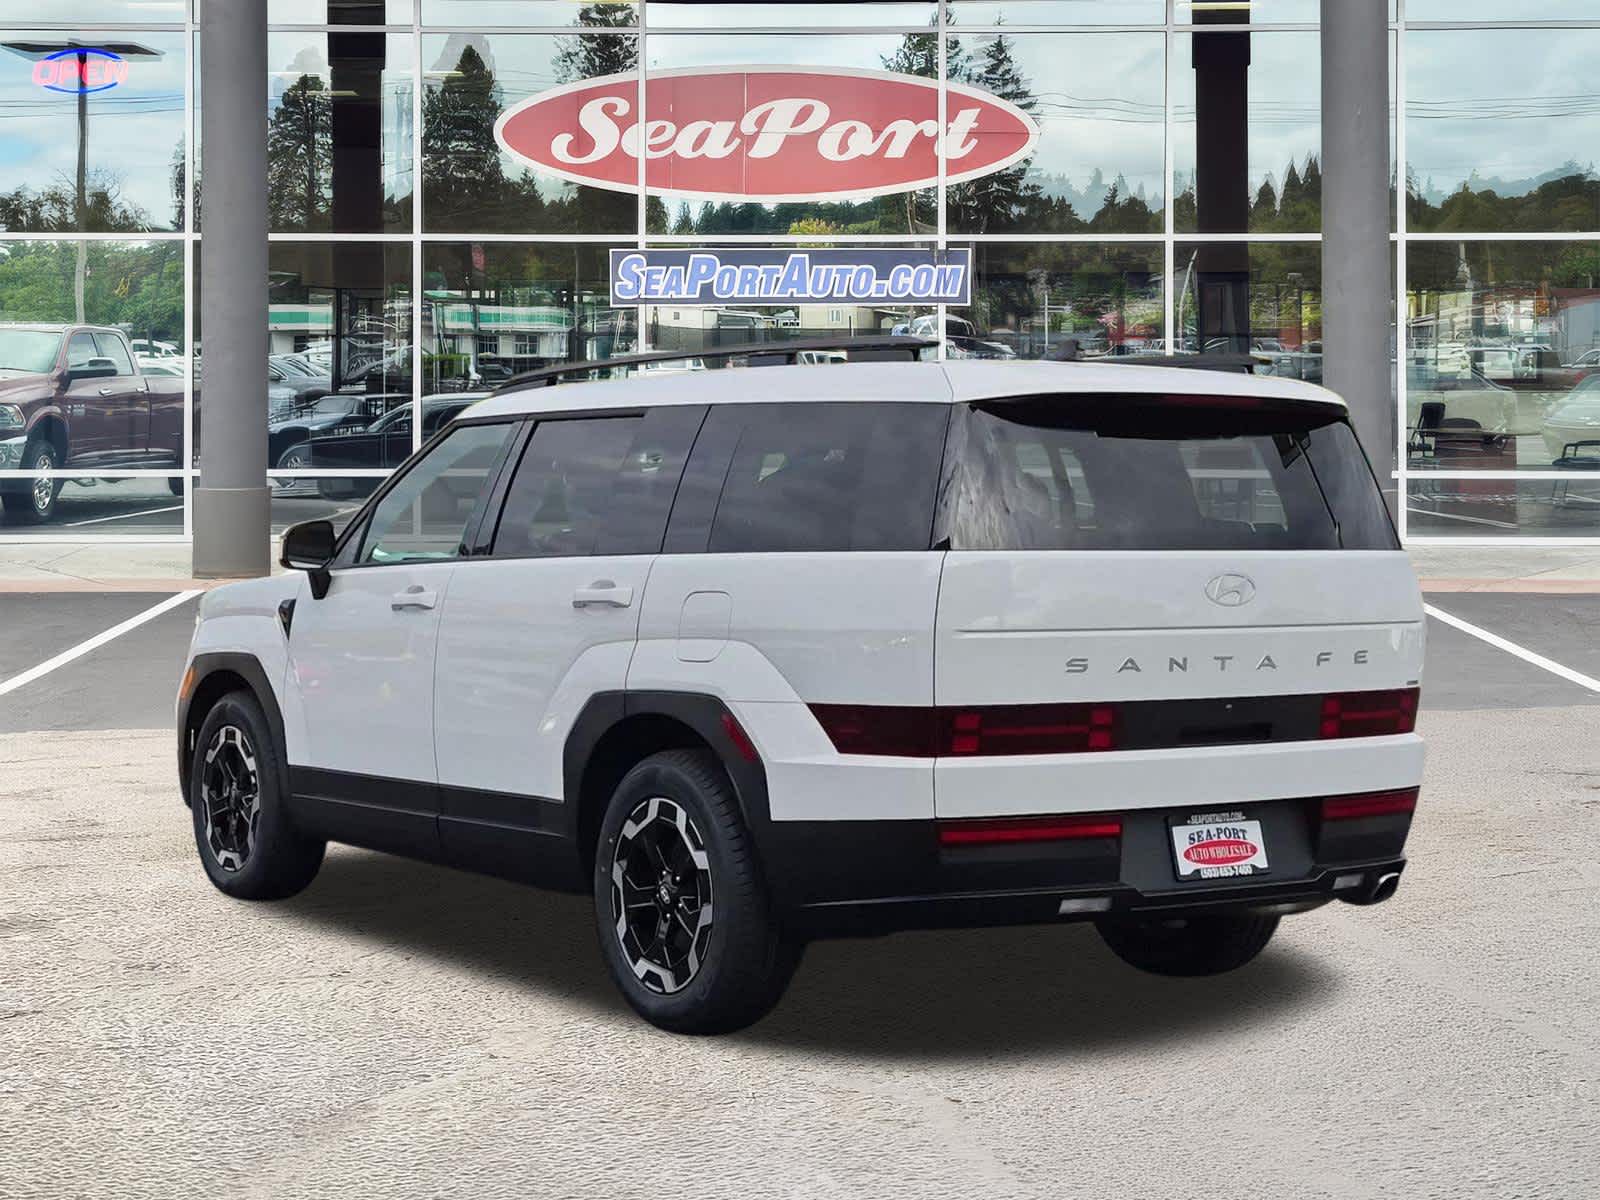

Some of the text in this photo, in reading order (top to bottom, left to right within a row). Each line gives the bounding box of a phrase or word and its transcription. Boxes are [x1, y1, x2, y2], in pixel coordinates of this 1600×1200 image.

[32, 59, 129, 86] OPEN
[550, 96, 982, 164] SeaPort
[1065, 650, 1368, 673] SANTA FE
[1188, 844, 1253, 861] AUTO WHOLESALE
